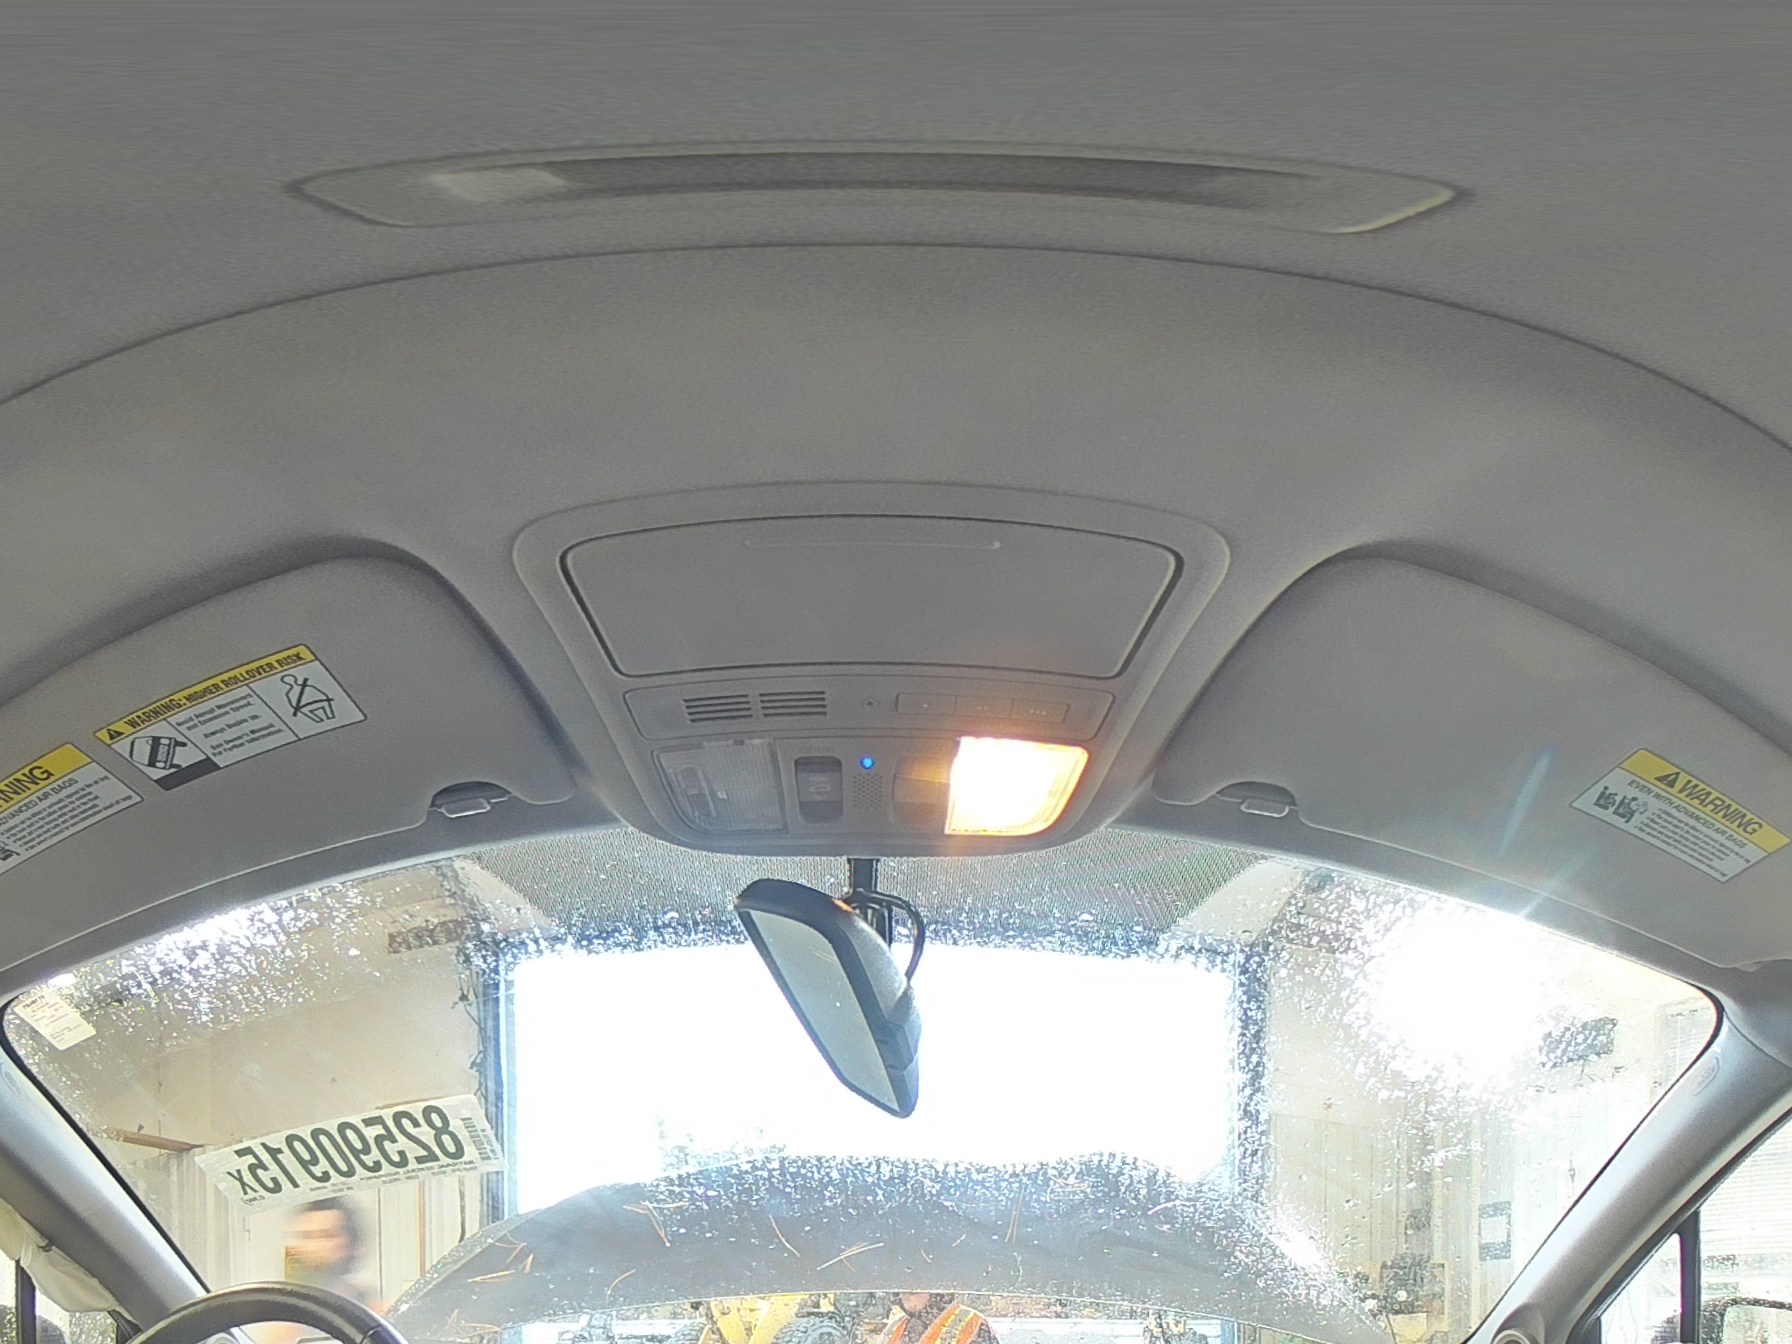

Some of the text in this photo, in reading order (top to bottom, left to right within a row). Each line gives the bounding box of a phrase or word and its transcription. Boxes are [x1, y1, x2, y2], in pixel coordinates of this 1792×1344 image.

[219, 661, 277, 688] ROLLOVER
[275, 651, 307, 669] RISK
[36, 790, 53, 804] AIR
[1677, 779, 1764, 836] WARNING
